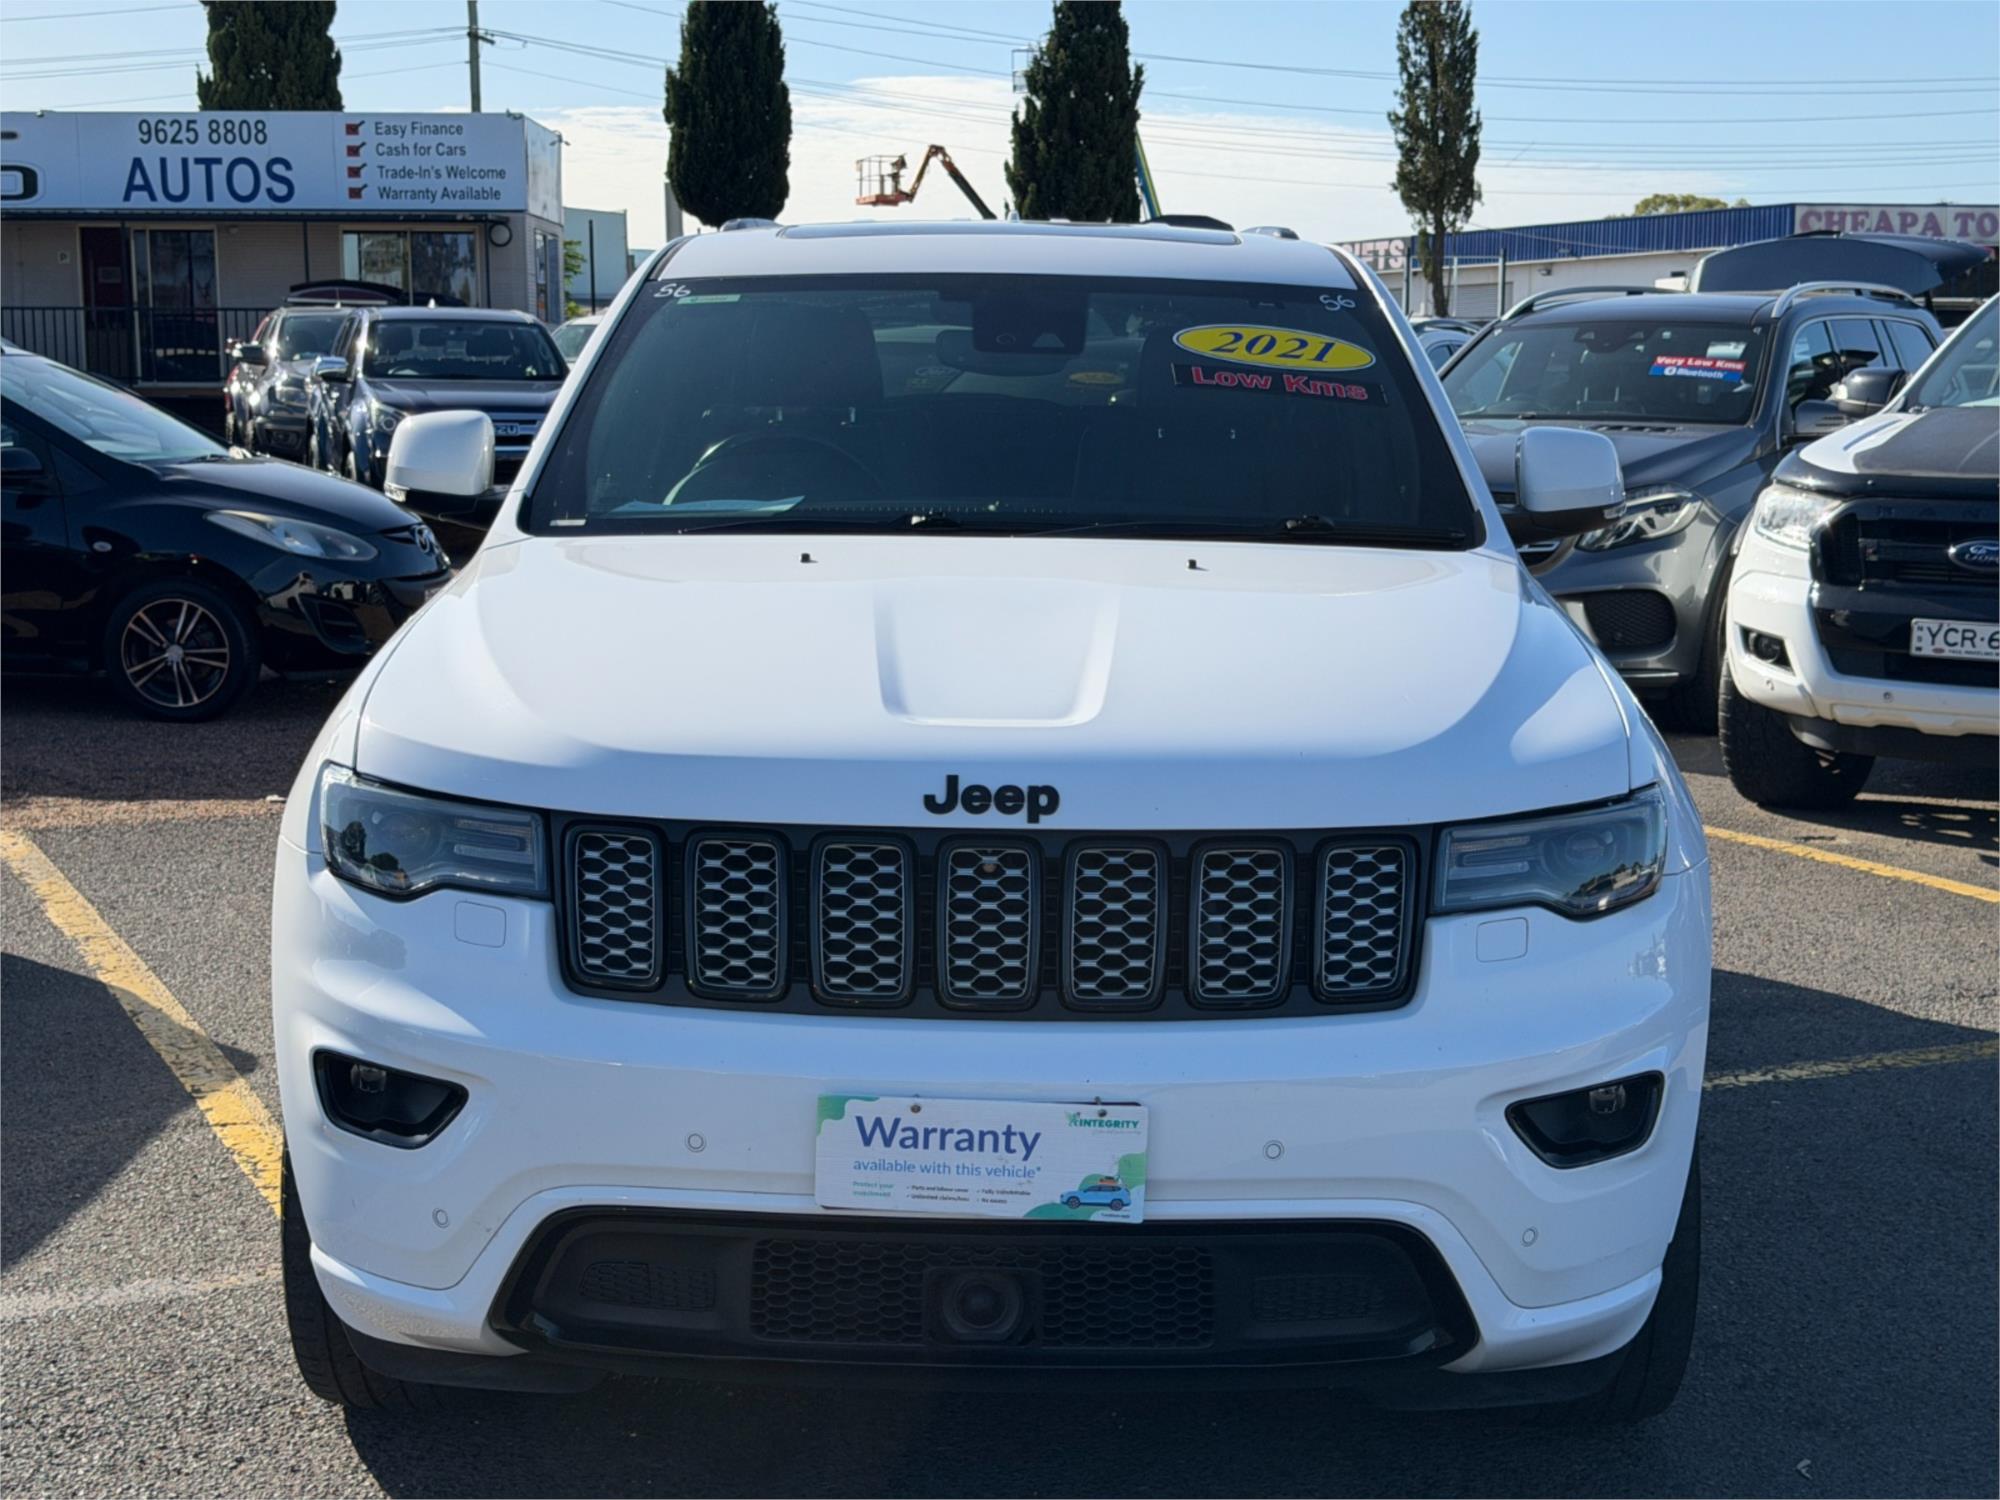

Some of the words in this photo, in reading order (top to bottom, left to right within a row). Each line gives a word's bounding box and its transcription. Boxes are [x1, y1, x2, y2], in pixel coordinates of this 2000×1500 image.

[138, 119, 199, 145] 9625
[207, 119, 268, 145] 8808
[374, 121, 407, 138] Easy
[411, 121, 464, 136] Finance
[375, 142, 410, 157] Cash
[413, 142, 432, 157] for
[435, 142, 467, 157] Cars
[123, 156, 295, 203] AUTOS
[376, 165, 442, 180] Trade-In's
[445, 165, 507, 180] Welcome
[377, 186, 438, 204] Warranty
[441, 186, 502, 201] Available
[1799, 209, 1945, 238] CHEAPA
[1211, 331, 1336, 363] 2021
[1655, 355, 1685, 367] Very
[1686, 357, 1713, 368] Low
[1715, 359, 1745, 370] Kms
[1191, 366, 1272, 390] Low
[1282, 373, 1368, 400] Kms
[922, 773, 1061, 825] Jeep
[1078, 1118, 1139, 1129] INTEGRITY
[854, 1114, 1042, 1162] Warranty
[853, 1158, 917, 1174] available
[919, 1161, 952, 1175] with
[955, 1161, 982, 1177] this
